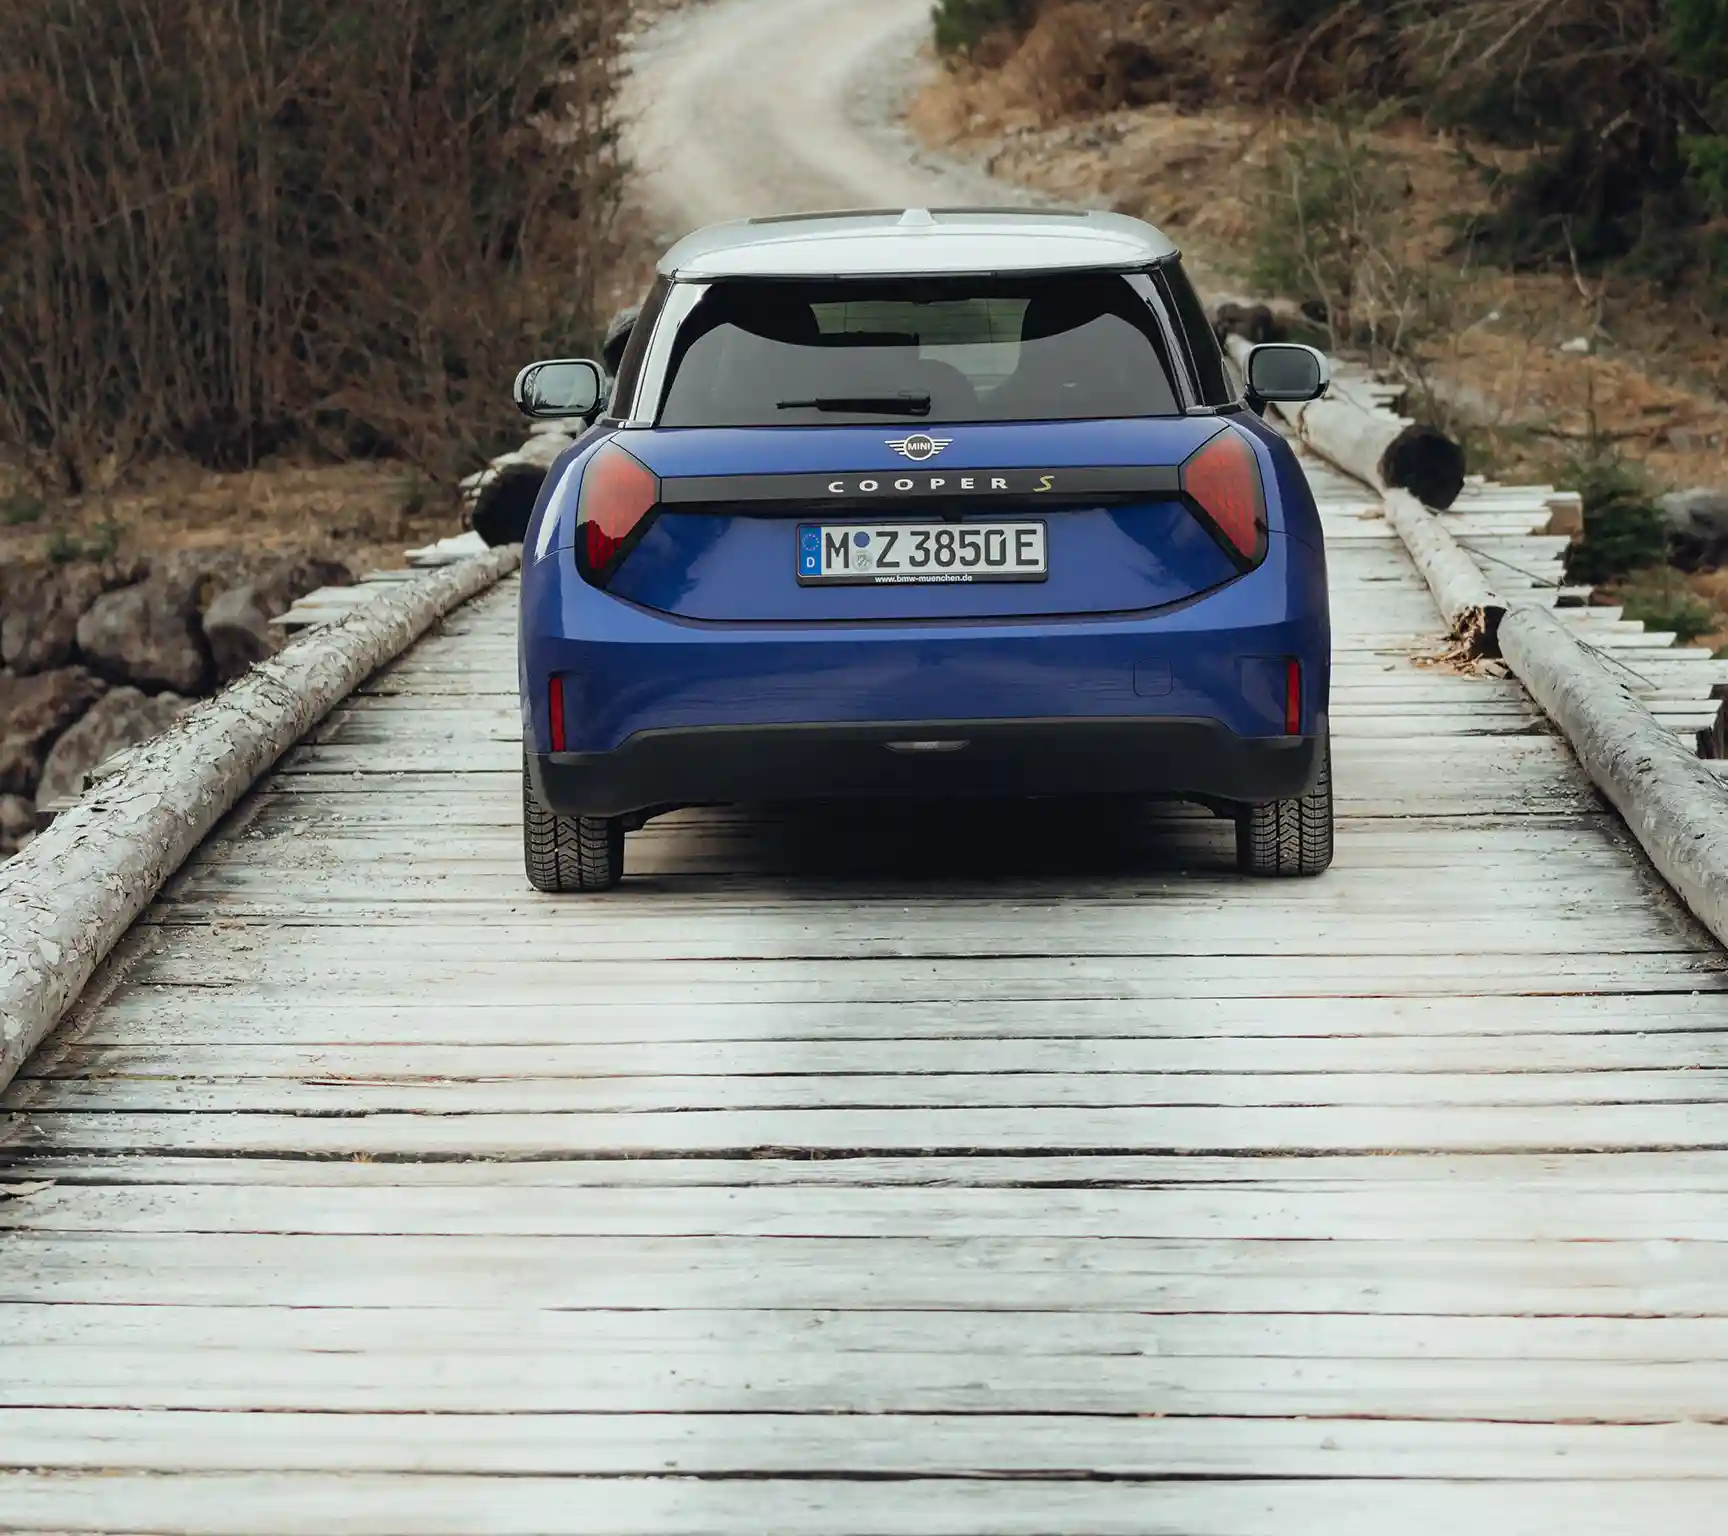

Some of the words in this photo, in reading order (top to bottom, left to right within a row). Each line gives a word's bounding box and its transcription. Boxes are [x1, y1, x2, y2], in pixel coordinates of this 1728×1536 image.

[907, 442, 931, 451] MINI
[828, 477, 1008, 493] COOPER
[1033, 475, 1055, 492] S
[806, 556, 815, 568] D
[875, 574, 973, 583] www.bmw-muenchen.de
